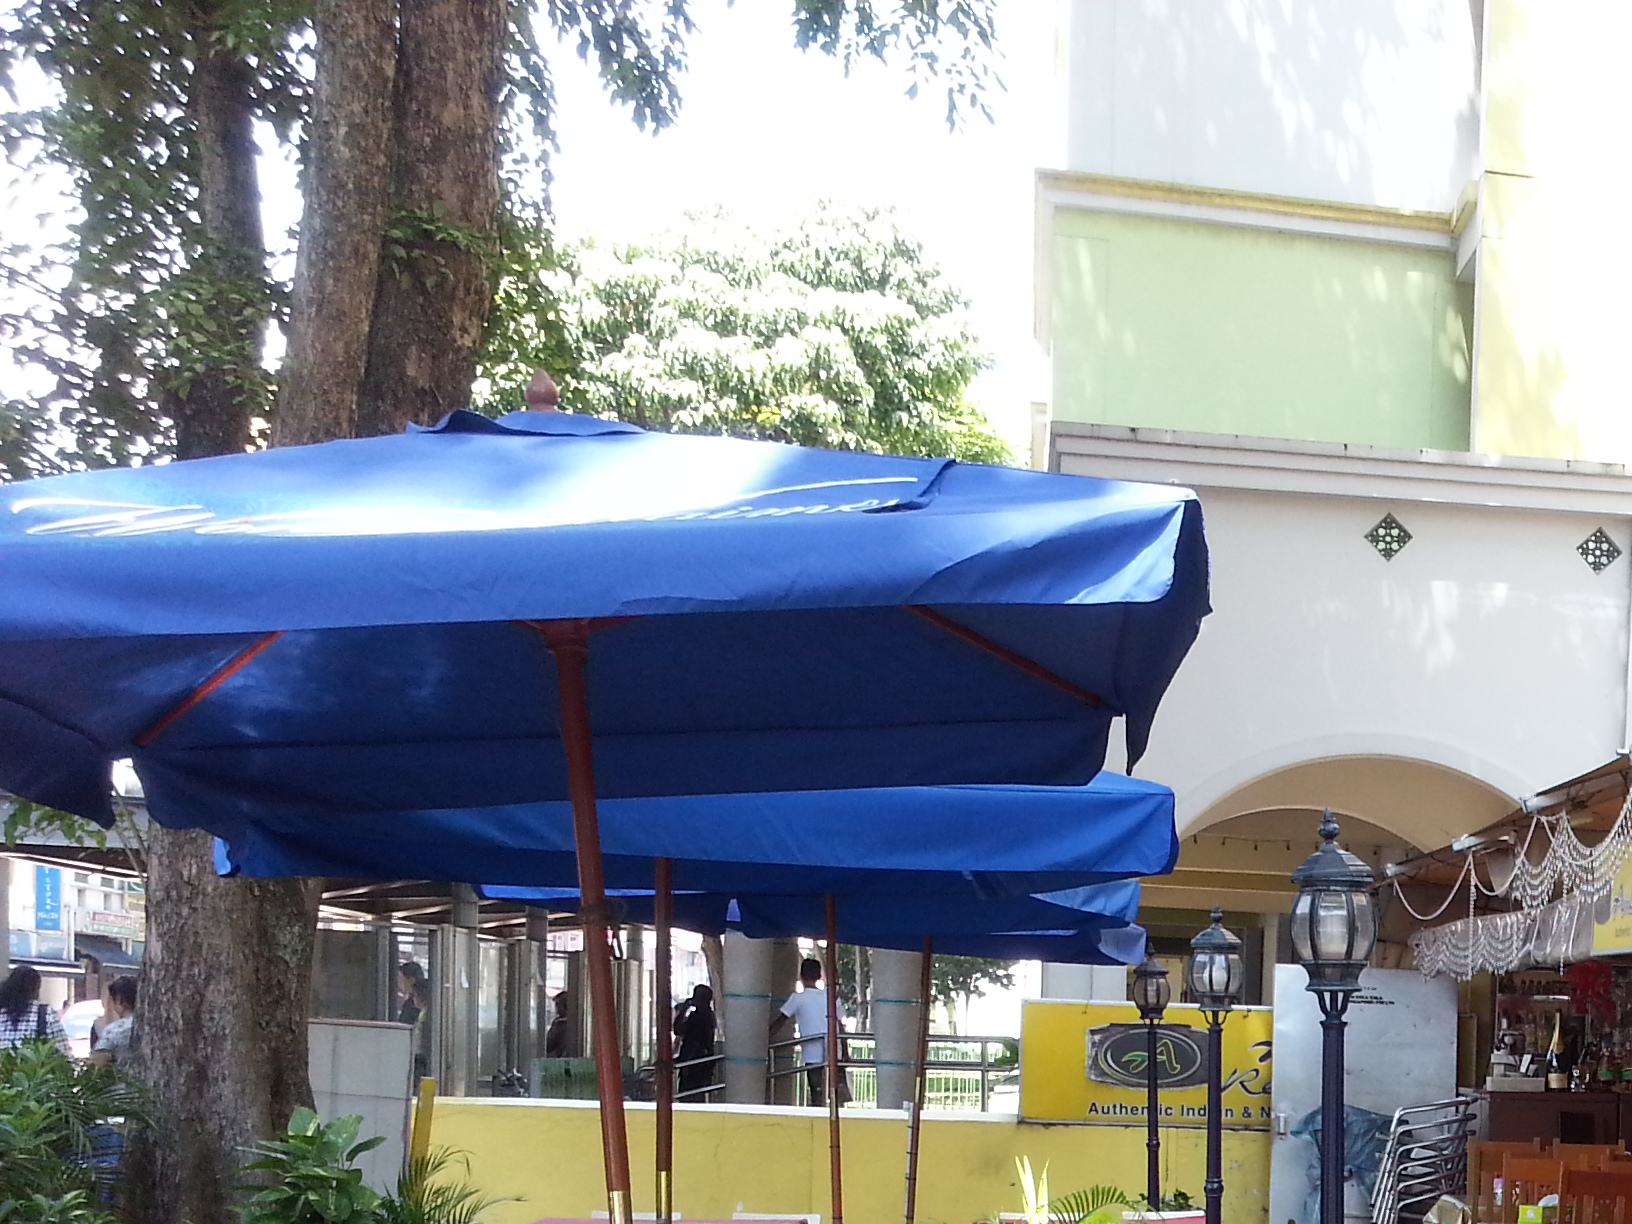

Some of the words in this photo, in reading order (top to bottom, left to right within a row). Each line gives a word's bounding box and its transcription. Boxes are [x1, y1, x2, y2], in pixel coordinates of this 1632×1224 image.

[1088, 1101, 1178, 1118] Authenic
[1180, 1104, 1234, 1119] Indn
[1242, 1105, 1252, 1119] &
